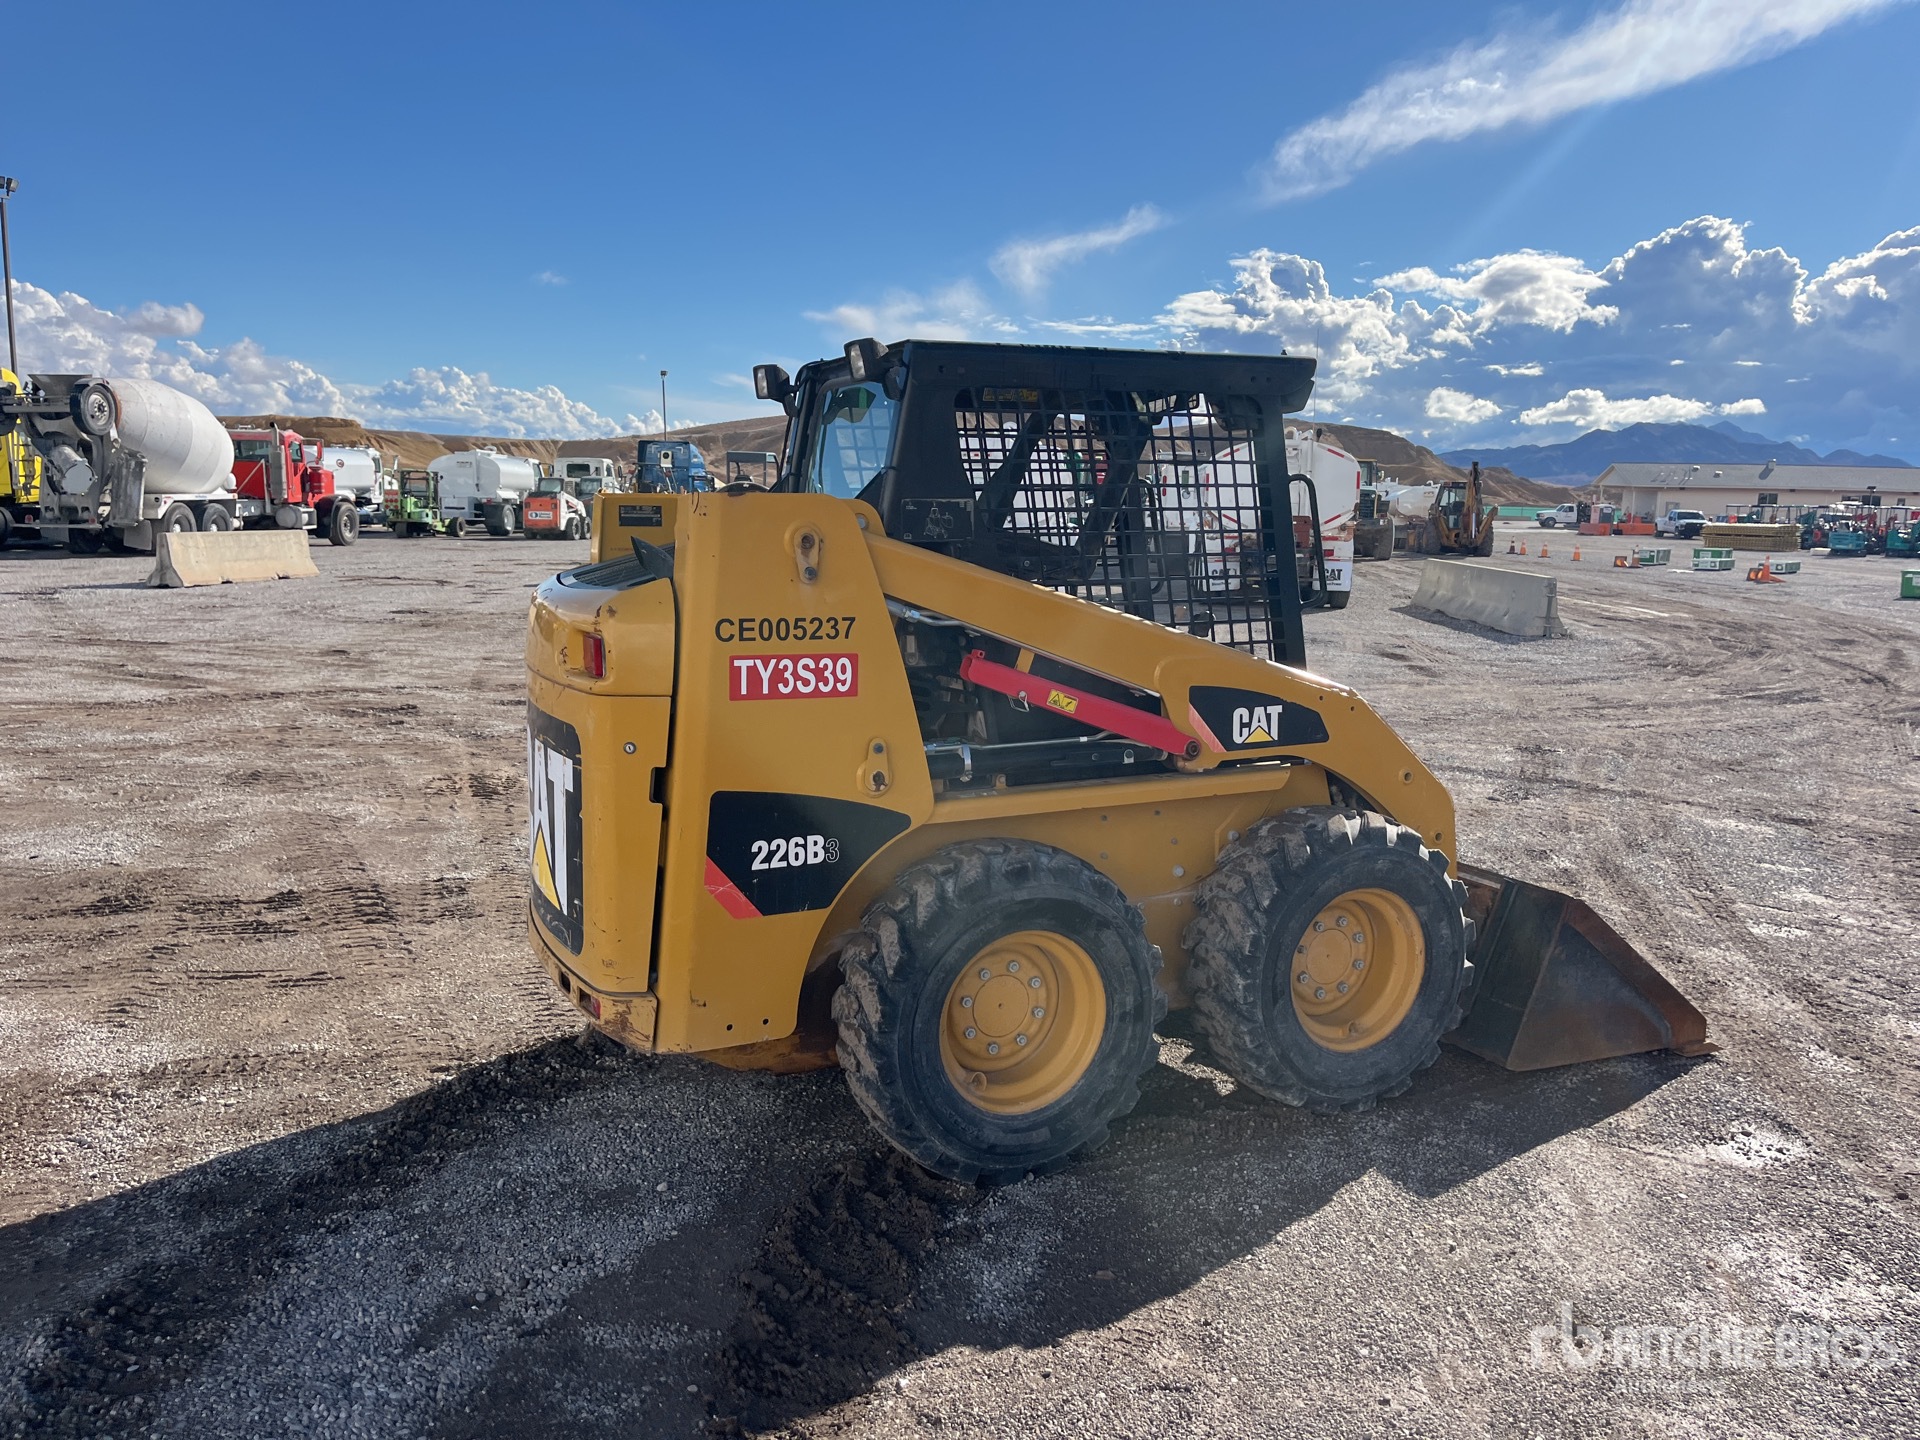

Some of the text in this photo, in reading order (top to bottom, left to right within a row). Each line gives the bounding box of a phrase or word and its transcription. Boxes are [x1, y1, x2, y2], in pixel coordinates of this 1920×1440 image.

[715, 617, 856, 642] CE005237
[733, 656, 853, 695] TY3S39
[1233, 705, 1283, 744] CAT
